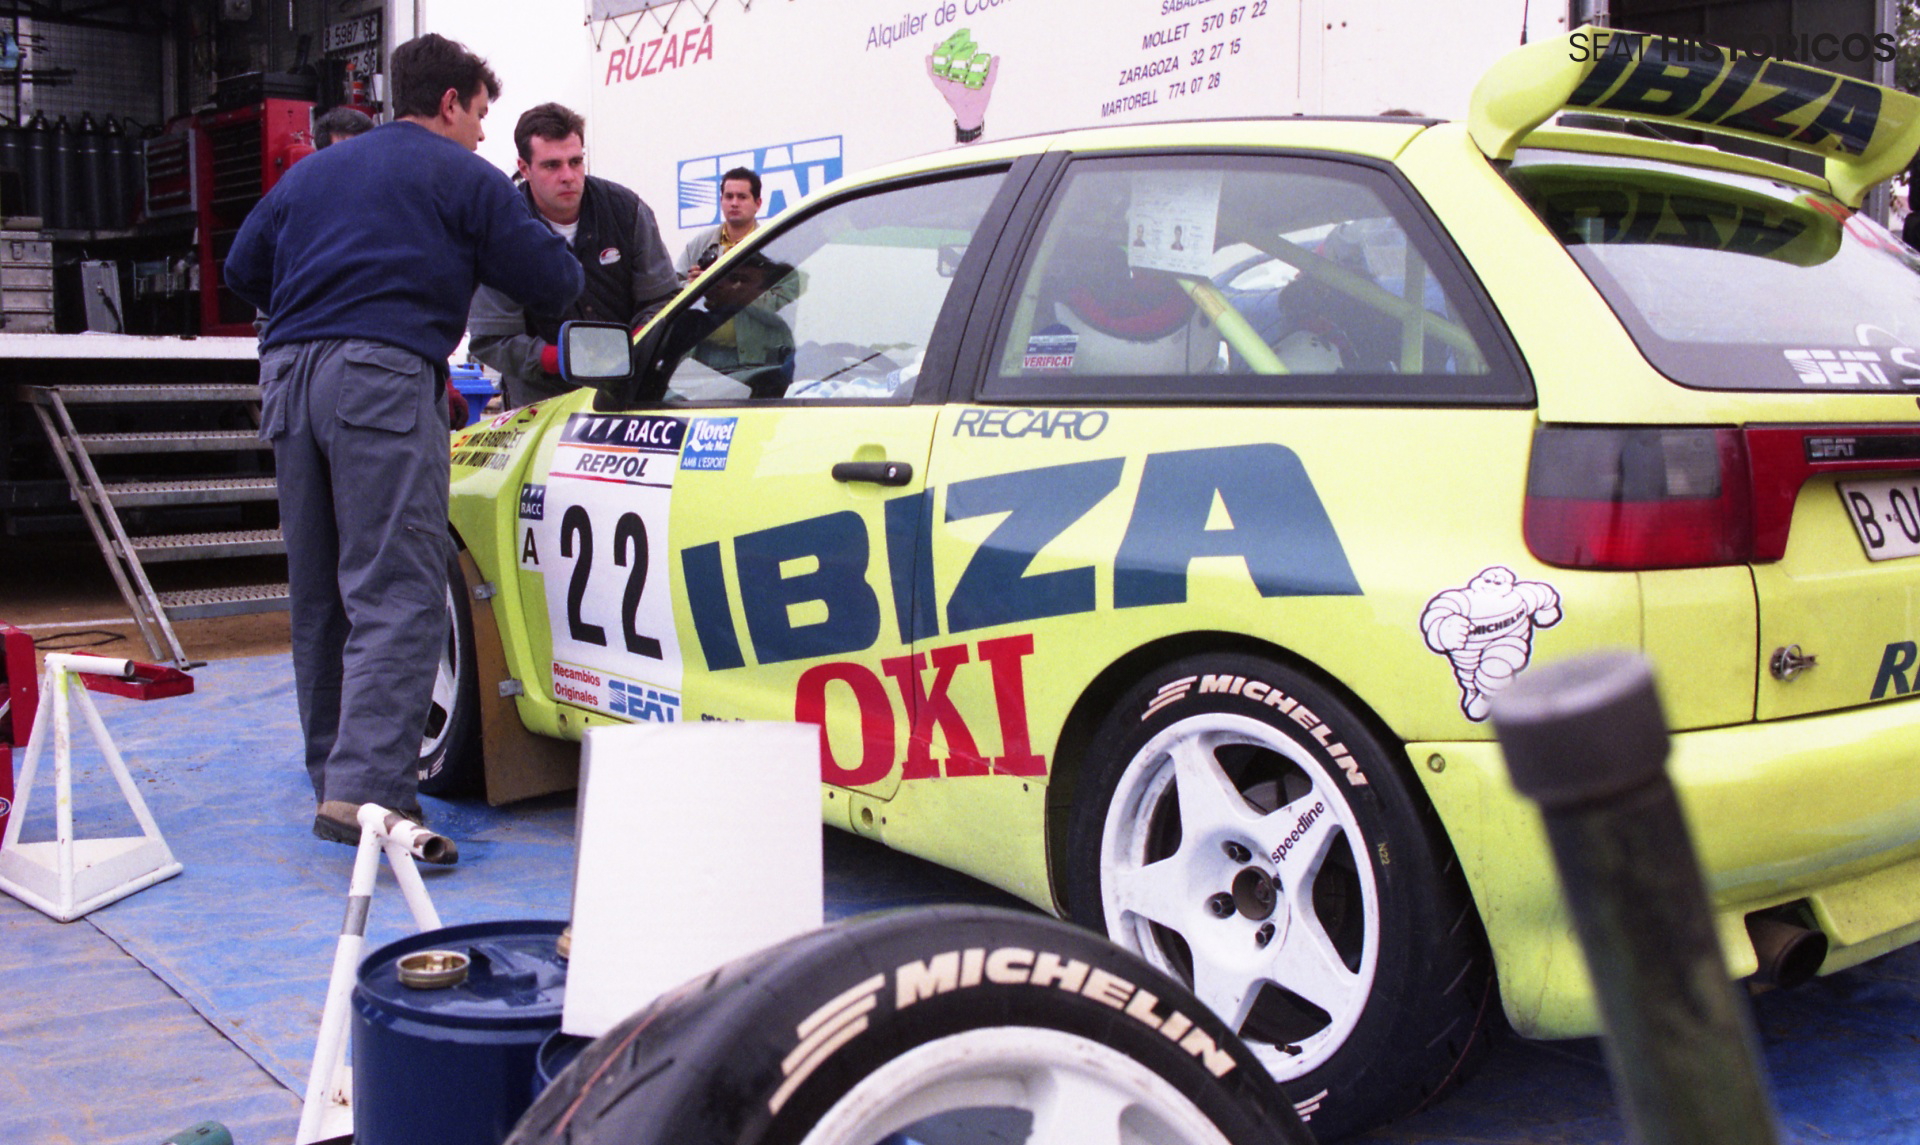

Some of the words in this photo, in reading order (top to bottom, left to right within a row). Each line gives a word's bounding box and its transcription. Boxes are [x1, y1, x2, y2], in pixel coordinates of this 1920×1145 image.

[866, 13, 927, 51] Alquiler
[935, 1, 956, 26] de
[1142, 23, 1190, 50] MOLLET
[1201, 13, 1224, 33] 570
[1230, 6, 1246, 25] 67
[1251, 0, 1268, 18] 22
[605, 25, 714, 86] RUZAFA
[1119, 55, 1179, 86] ZARAGOZA
[1190, 48, 1205, 66] 32
[1209, 43, 1224, 61] 27
[1230, 38, 1242, 55] 15
[1101, 90, 1158, 117] MARTORELL
[1168, 81, 1186, 99] 774
[1190, 76, 1203, 94] 07
[1207, 72, 1221, 90] 28
[1566, 32, 1883, 157] IBIZA
[1024, 355, 1073, 368] VERIFICAT
[1784, 349, 1890, 385] SEAT
[624, 419, 677, 444] RACC
[686, 420, 734, 452] Lloret
[953, 408, 1109, 441] RECARO
[575, 453, 649, 478] REPSOL
[682, 457, 697, 468] AMB
[1810, 438, 1856, 457] SEAT
[520, 502, 542, 515] RACC
[522, 527, 540, 565] A
[681, 442, 1365, 672] IBIZA
[560, 504, 664, 661] 22
[1468, 608, 1525, 635] MICHELIN
[553, 662, 601, 686] Recambios
[555, 683, 599, 707] Originales
[608, 679, 680, 722] SEAT
[795, 633, 1048, 788] OKI
[1199, 674, 1368, 787] MICHELIN
[1271, 801, 1325, 864] speedline
[895, 946, 1237, 1078] MICHELIN
